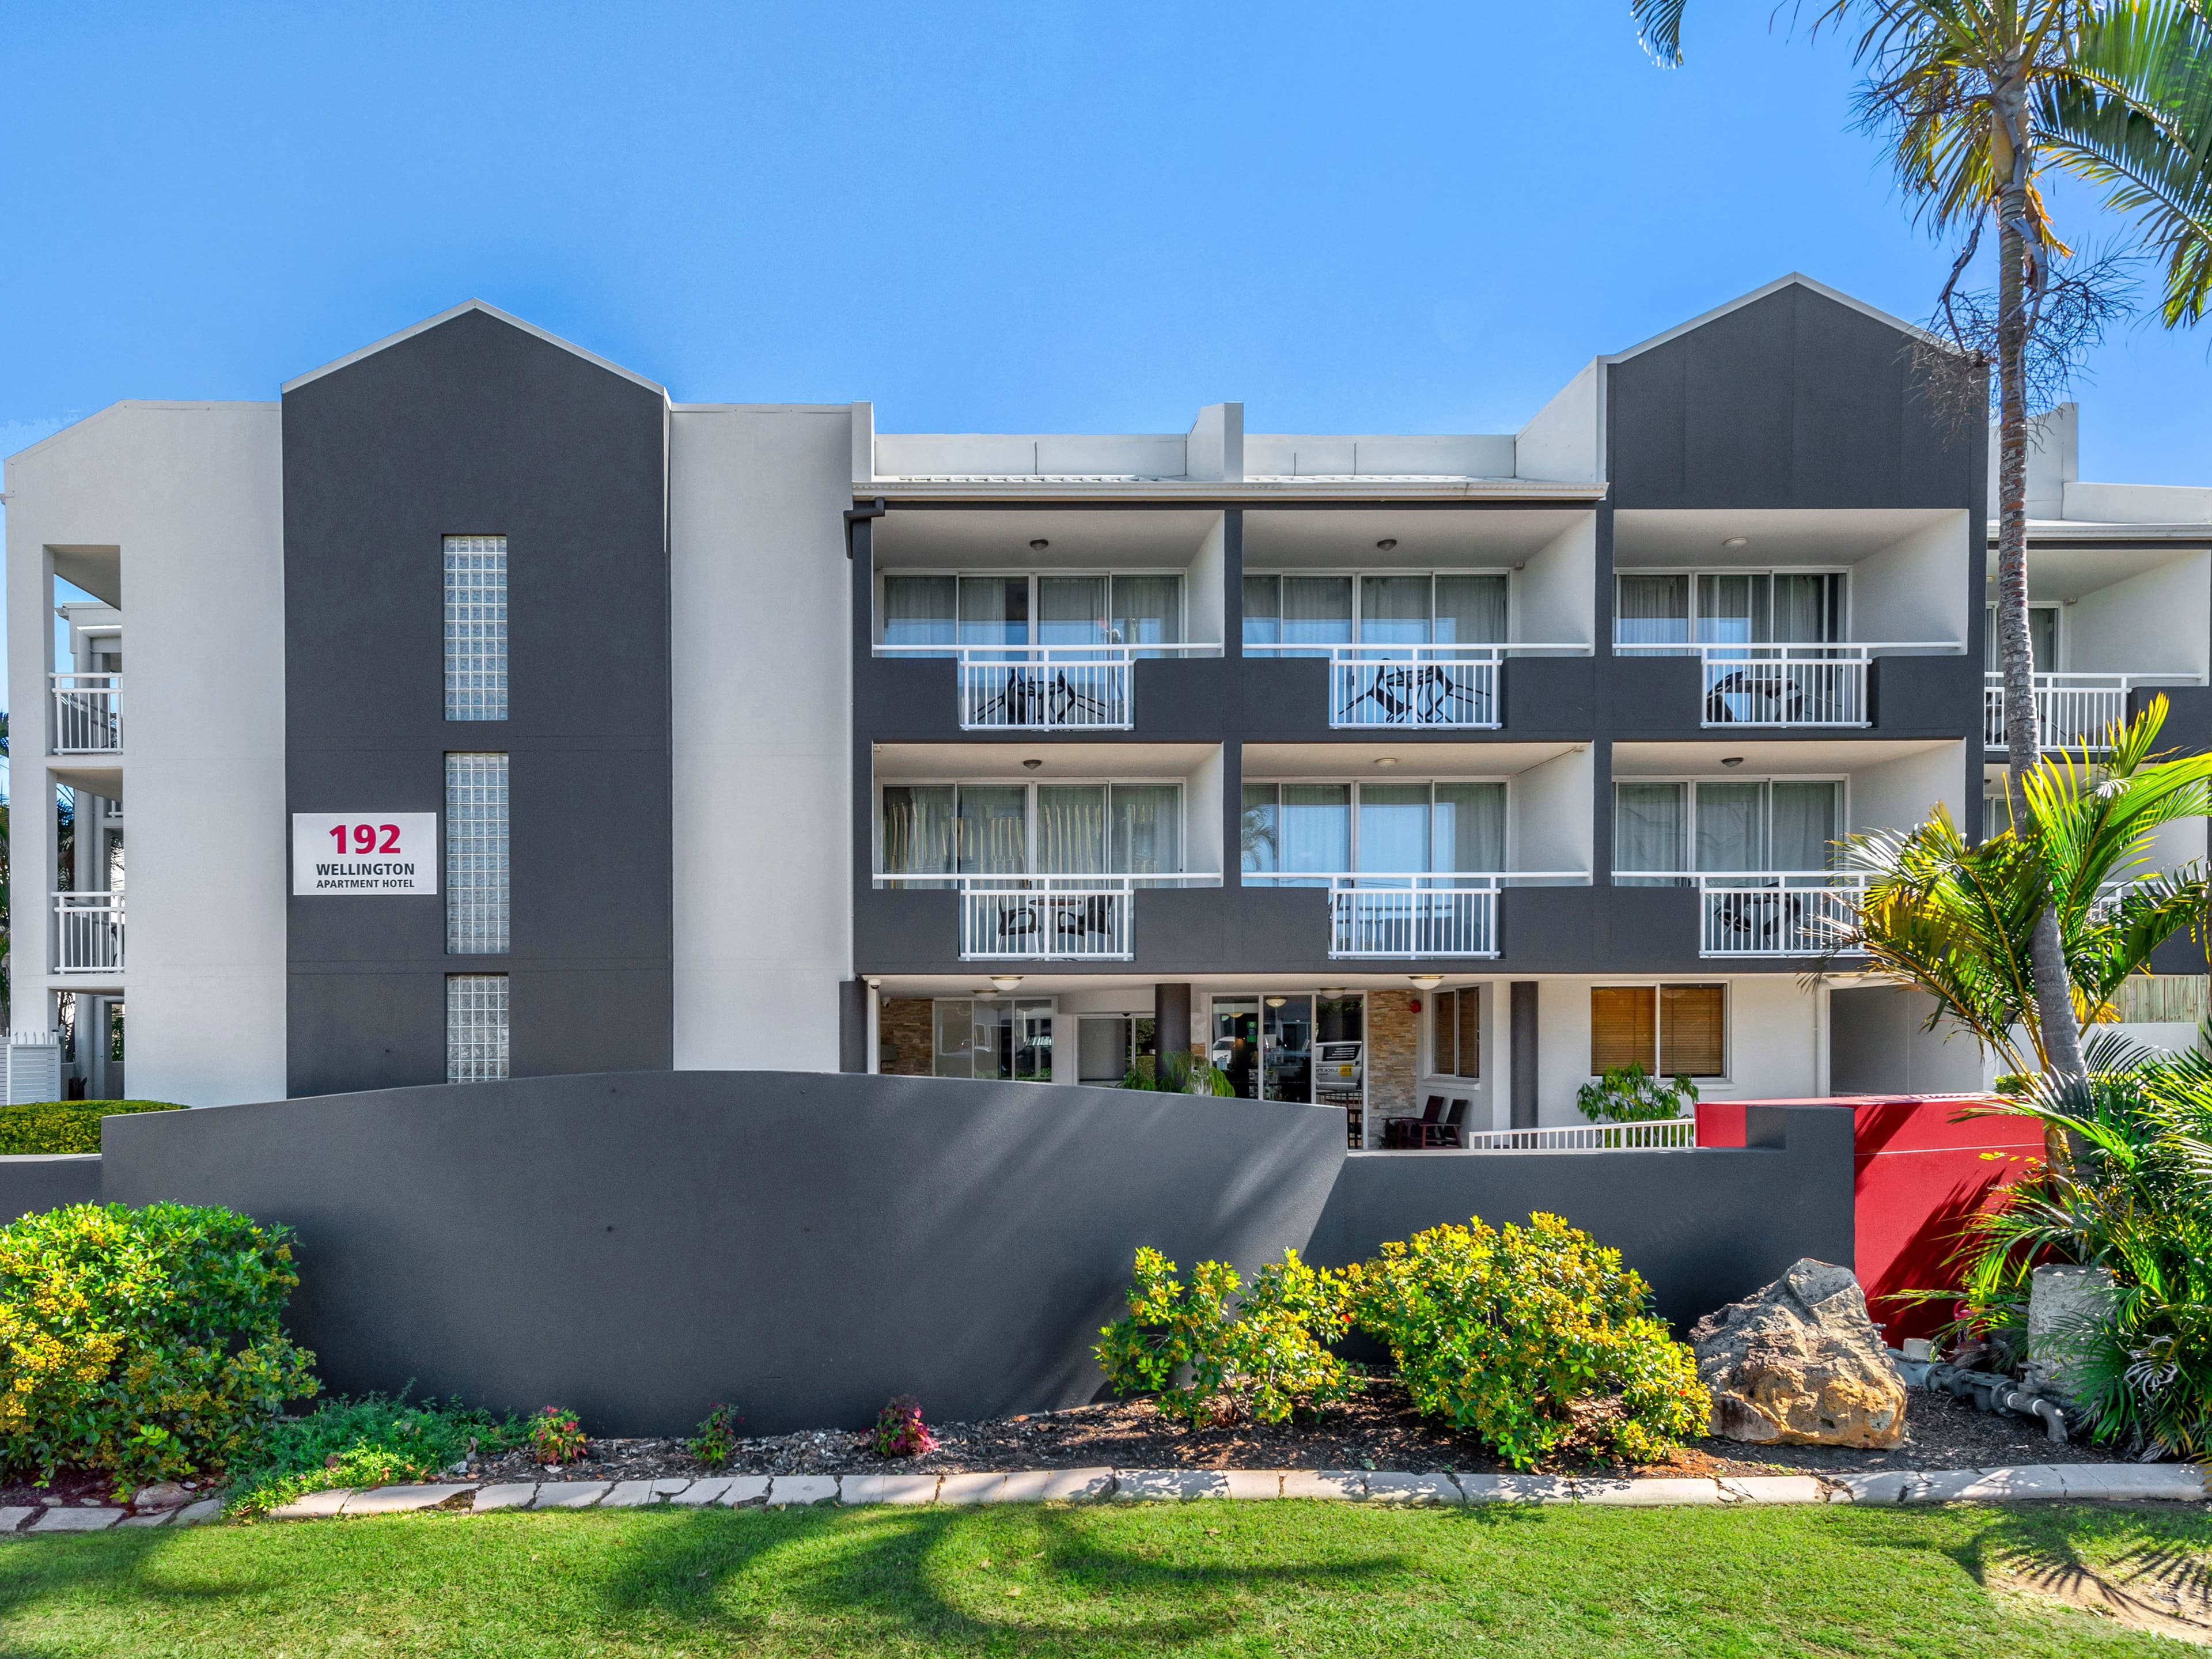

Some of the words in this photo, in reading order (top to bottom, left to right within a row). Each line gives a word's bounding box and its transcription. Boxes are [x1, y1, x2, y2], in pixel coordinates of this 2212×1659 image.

[329, 824, 401, 854] 192
[316, 863, 414, 876] WELLINGTON
[316, 880, 380, 888] APARTMENT
[382, 879, 415, 888] HOTEL
